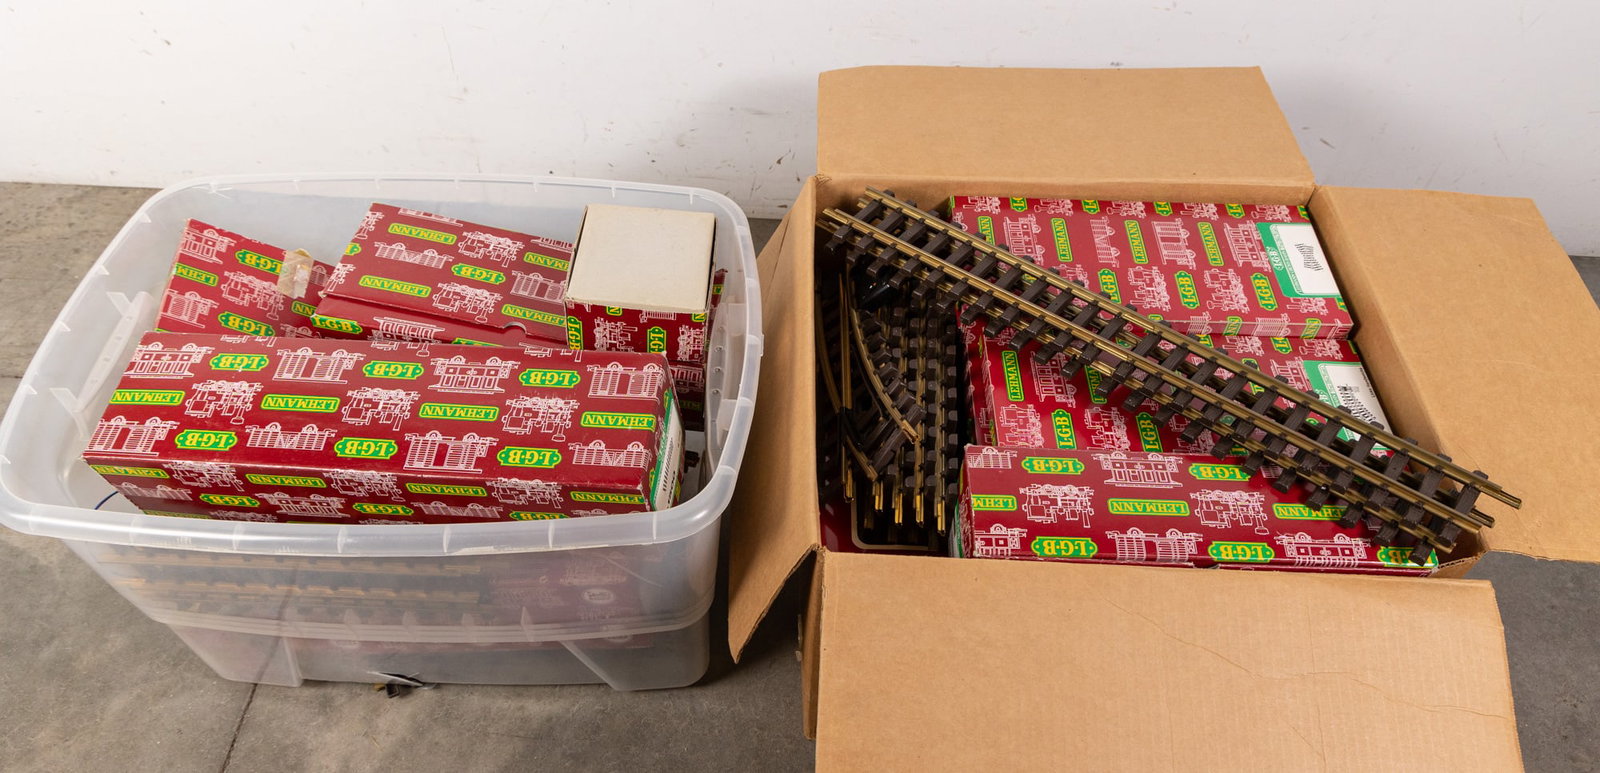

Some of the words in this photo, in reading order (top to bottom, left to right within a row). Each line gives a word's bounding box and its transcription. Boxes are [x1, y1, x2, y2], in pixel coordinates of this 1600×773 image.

[393, 225, 454, 243] LEHMANN
[1054, 219, 1071, 261] LEHMANN
[1127, 222, 1145, 262] LEHMANN
[1200, 224, 1223, 265] LEHMANN
[361, 277, 429, 296] LEHMANN
[1006, 353, 1023, 400] LEHMANN
[112, 392, 183, 404] LEHMANN
[264, 397, 337, 411] LEHMANN
[423, 405, 496, 419] LEHMANN
[250, 476, 322, 486] LEHMANN
[411, 485, 483, 495] LEHMANN
[1113, 502, 1185, 514] LEHMANN
